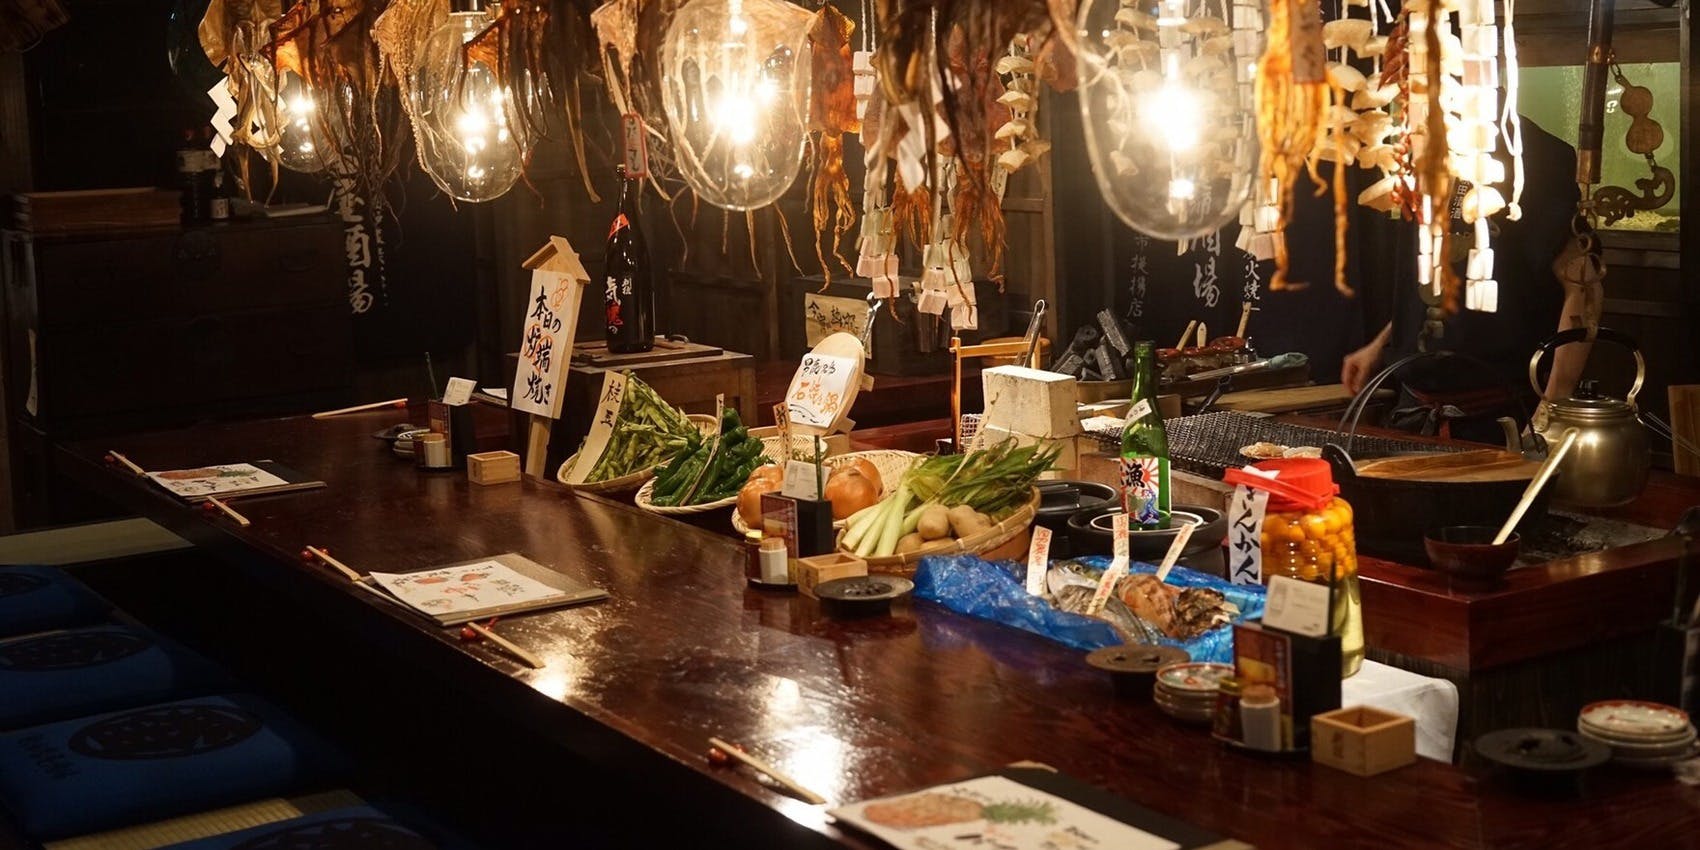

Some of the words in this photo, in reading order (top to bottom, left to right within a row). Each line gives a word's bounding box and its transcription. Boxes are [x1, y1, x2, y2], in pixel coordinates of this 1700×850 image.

[522, 285, 562, 405] 本日の炉端焼き
